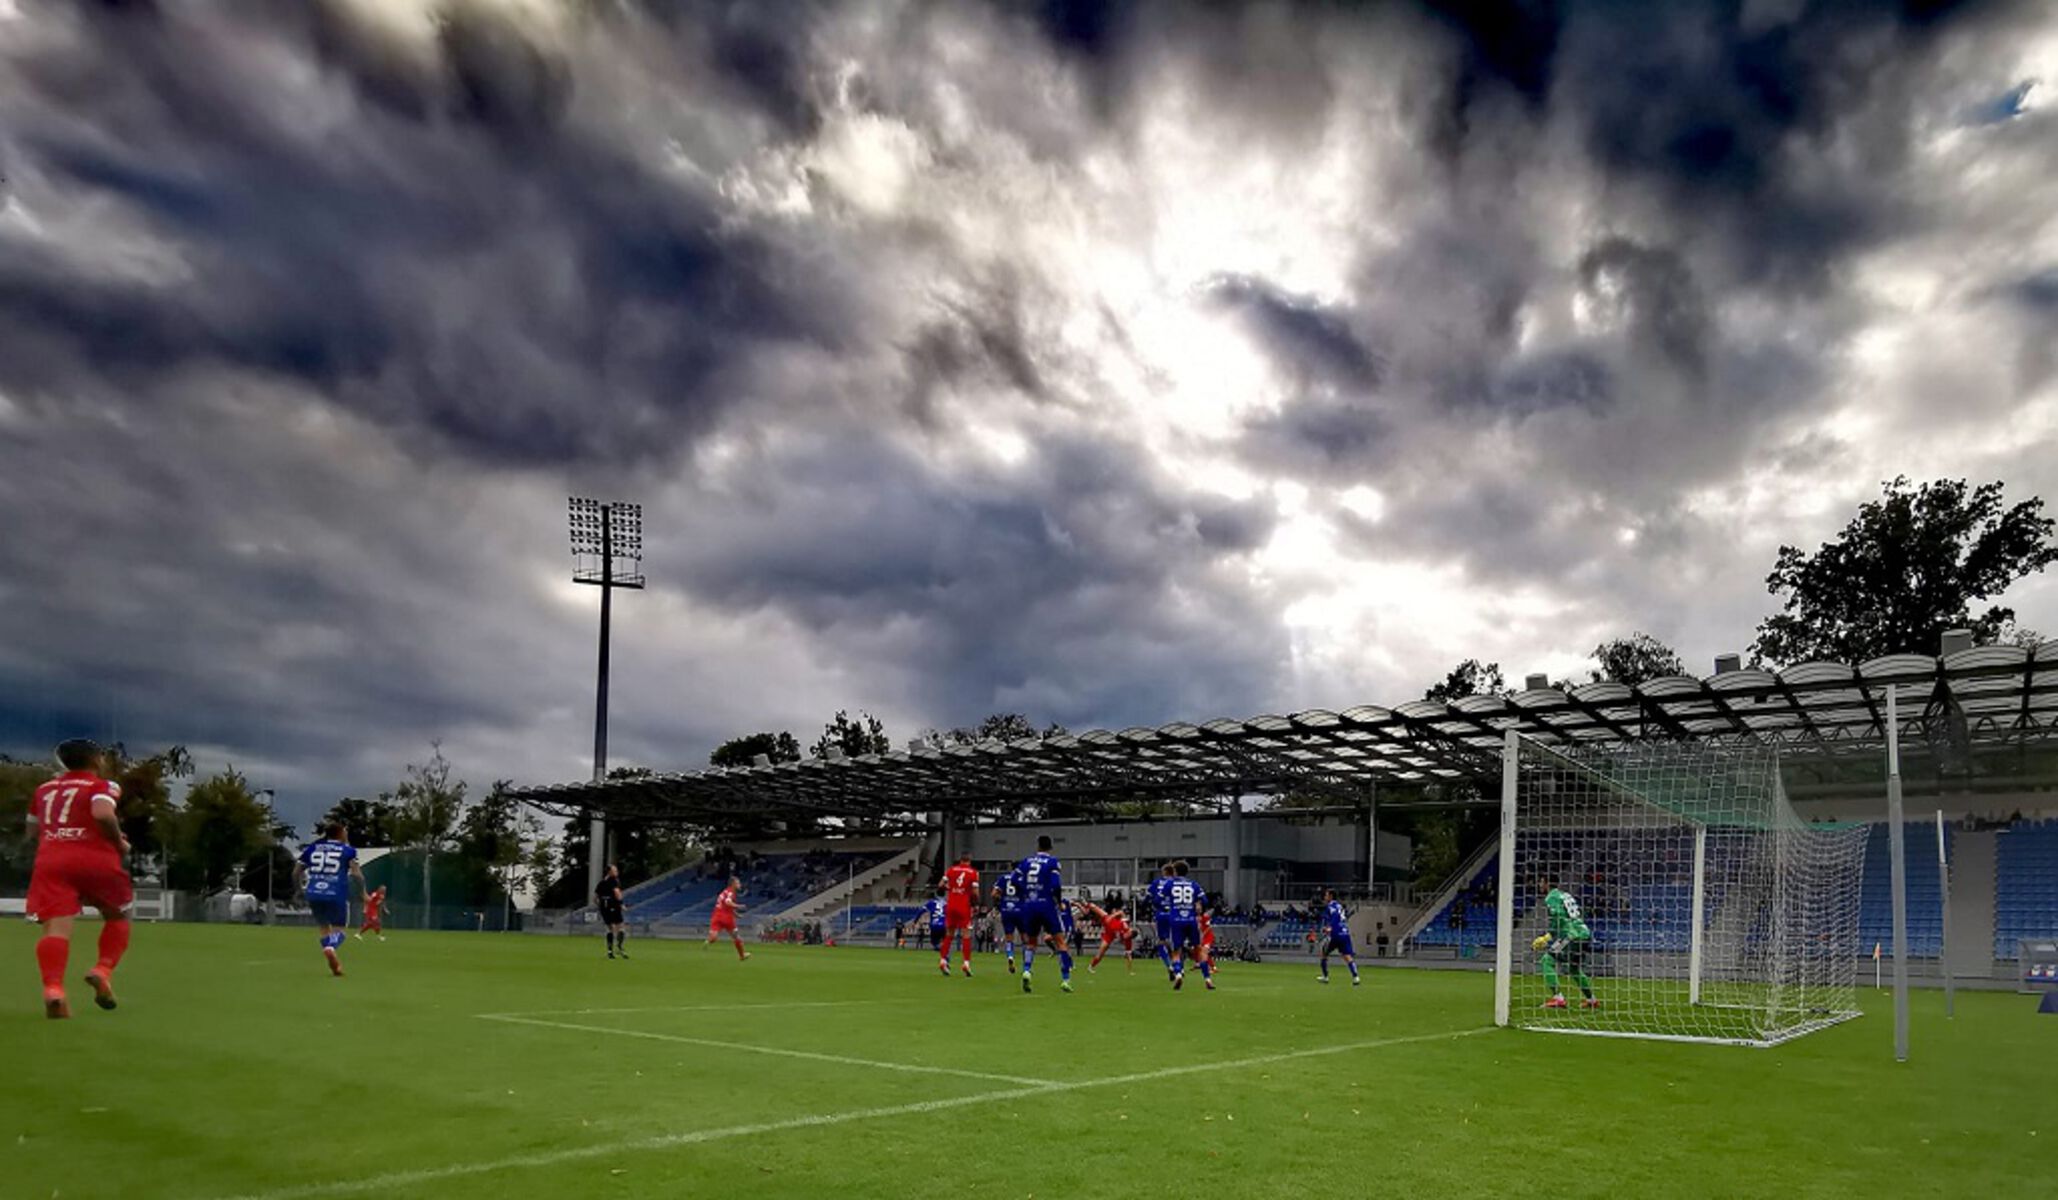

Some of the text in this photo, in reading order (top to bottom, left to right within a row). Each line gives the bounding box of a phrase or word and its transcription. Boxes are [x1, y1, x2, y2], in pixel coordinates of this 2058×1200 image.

[43, 788, 79, 824] 17
[311, 852, 342, 873] 95
[955, 872, 965, 887] 4
[1027, 863, 1041, 883] 2
[1006, 880, 1016, 896] 6
[1172, 886, 1194, 903] 98
